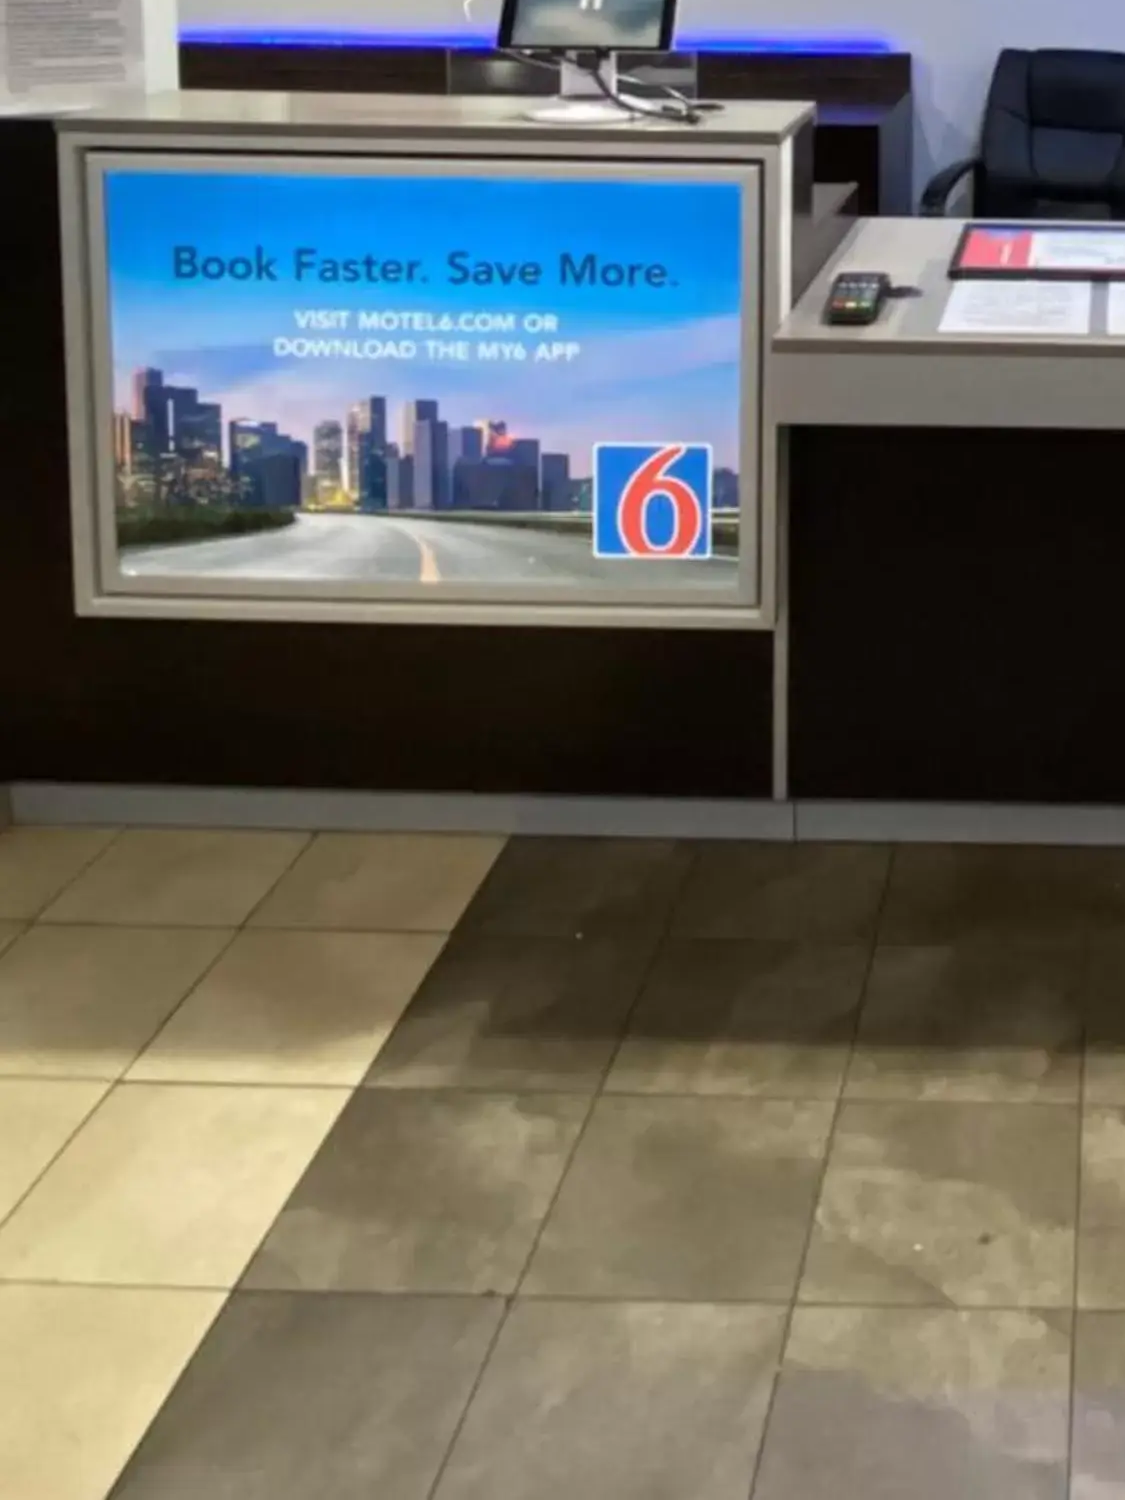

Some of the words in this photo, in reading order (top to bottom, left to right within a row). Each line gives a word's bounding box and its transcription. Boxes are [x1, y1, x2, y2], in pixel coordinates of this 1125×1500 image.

[173, 244, 278, 281] Book
[293, 247, 429, 284] Faster.
[447, 250, 543, 287] Save
[559, 252, 681, 289] More.
[292, 308, 349, 331] VISIT
[357, 309, 516, 334] MOTEL6.COM
[523, 312, 559, 334] OR
[273, 336, 417, 360] DOWNLOAD
[426, 339, 469, 361] THE
[476, 341, 528, 362] MY6
[534, 341, 581, 363] APP
[617, 442, 702, 558] 6
